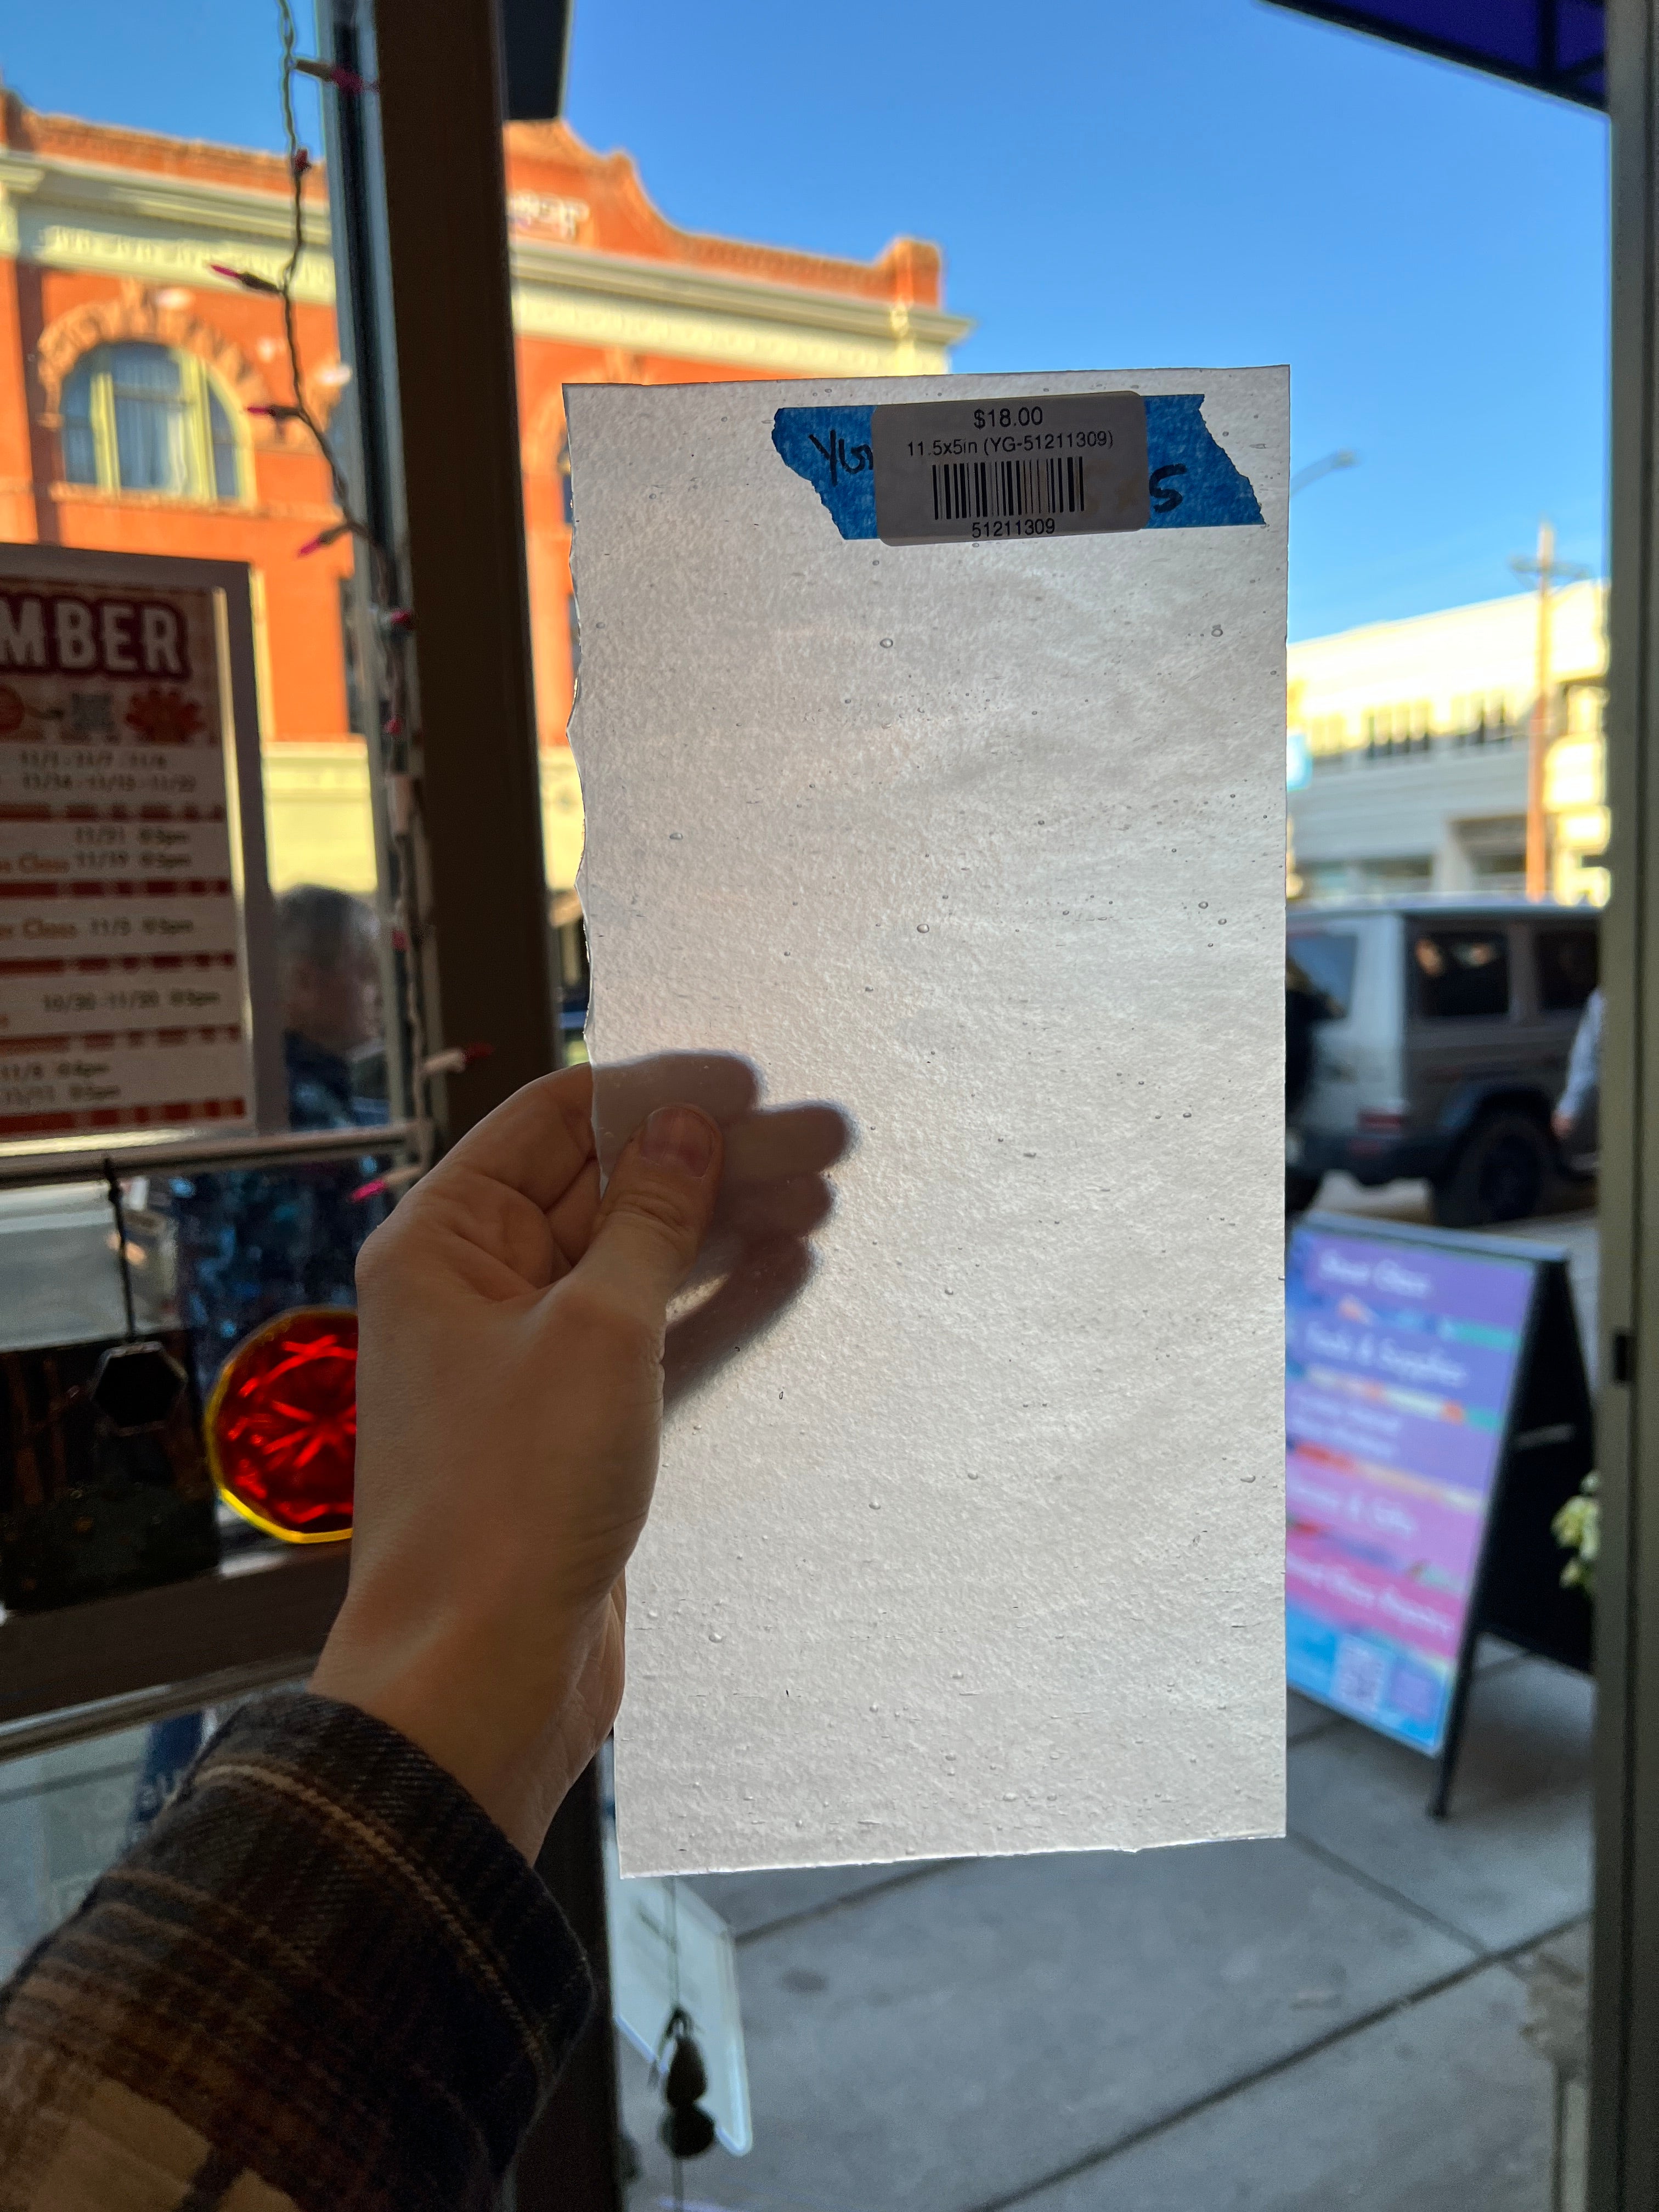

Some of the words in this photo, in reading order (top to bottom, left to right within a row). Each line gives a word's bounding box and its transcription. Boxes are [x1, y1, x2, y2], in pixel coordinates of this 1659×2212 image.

[973, 406, 1042, 430] $18.00
[908, 439, 978, 456] 11.5x5in
[984, 431, 1114, 456] (YG-51211309)
[972, 518, 1056, 539] 51211309
